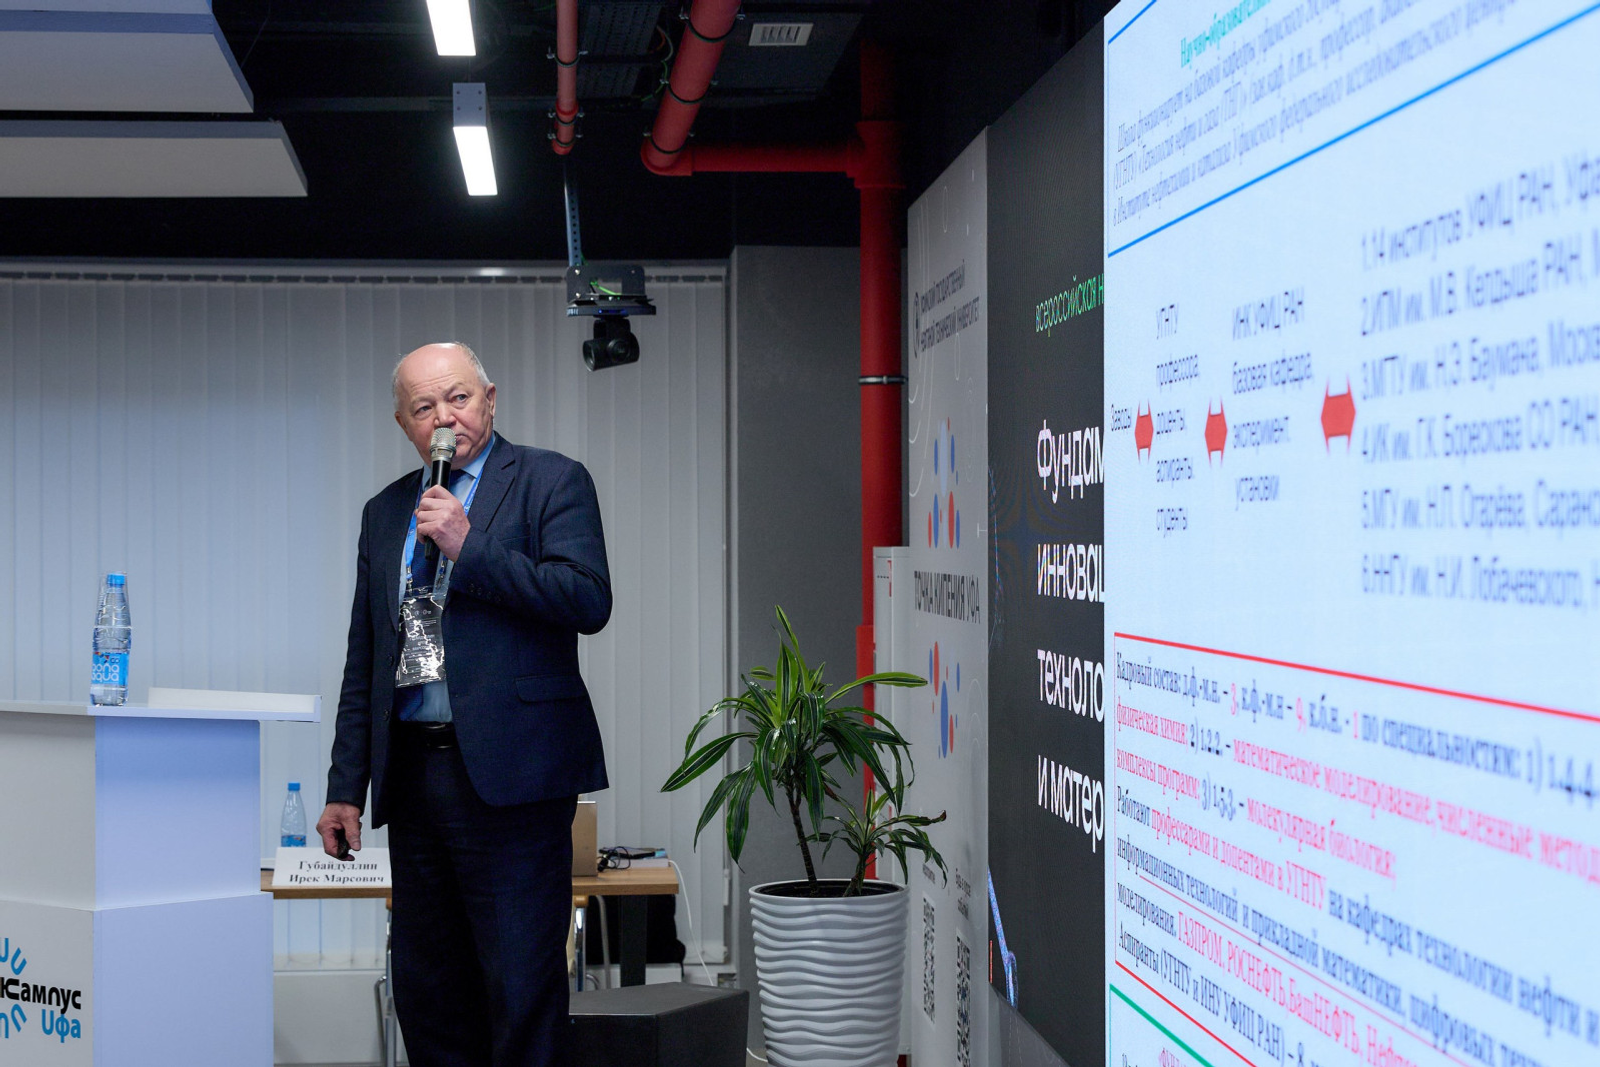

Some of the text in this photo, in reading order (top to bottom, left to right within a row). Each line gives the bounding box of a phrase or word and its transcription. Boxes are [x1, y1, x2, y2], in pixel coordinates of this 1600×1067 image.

[1035, 275, 1096, 337] всероссийская
[914, 570, 980, 624] ТОЧКА КИПЕНИЯ УФА
[1037, 649, 1104, 723] техноло
[1117, 651, 1152, 690] Кадровый
[1153, 667, 1182, 694] состав:
[1362, 712, 1379, 743] по
[1381, 717, 1522, 779] специальностям:
[1038, 754, 1104, 853] и матер
[1117, 695, 1159, 737] физическая
[1233, 739, 1321, 788] математическое
[1323, 766, 1437, 838] моделирование,
[1436, 799, 1534, 860] численные
[1117, 748, 1156, 782] комплексы
[1247, 797, 1326, 853] молекулярная
[289, 874, 384, 884] Ирек Марсович
[299, 861, 378, 872] Губайдуллин
[1117, 785, 1151, 826] Работают
[1212, 836, 1219, 859] и
[1220, 840, 1275, 888] доцентами
[1286, 859, 1326, 911] УГНТУ
[1328, 888, 1343, 921] на
[1416, 929, 1513, 1006] технологии
[1517, 975, 1581, 1039] нефти
[1117, 834, 1185, 894] информационных
[1186, 873, 1238, 923] технологий
[1242, 903, 1249, 929] и
[1251, 908, 1318, 968] прикладной
[1410, 992, 1495, 1067] цифровых
[1119, 920, 1159, 975] Аспиранты
[1160, 947, 1192, 996] (УГНТУ
[1223, 990, 1256, 1050] УФИЦ
